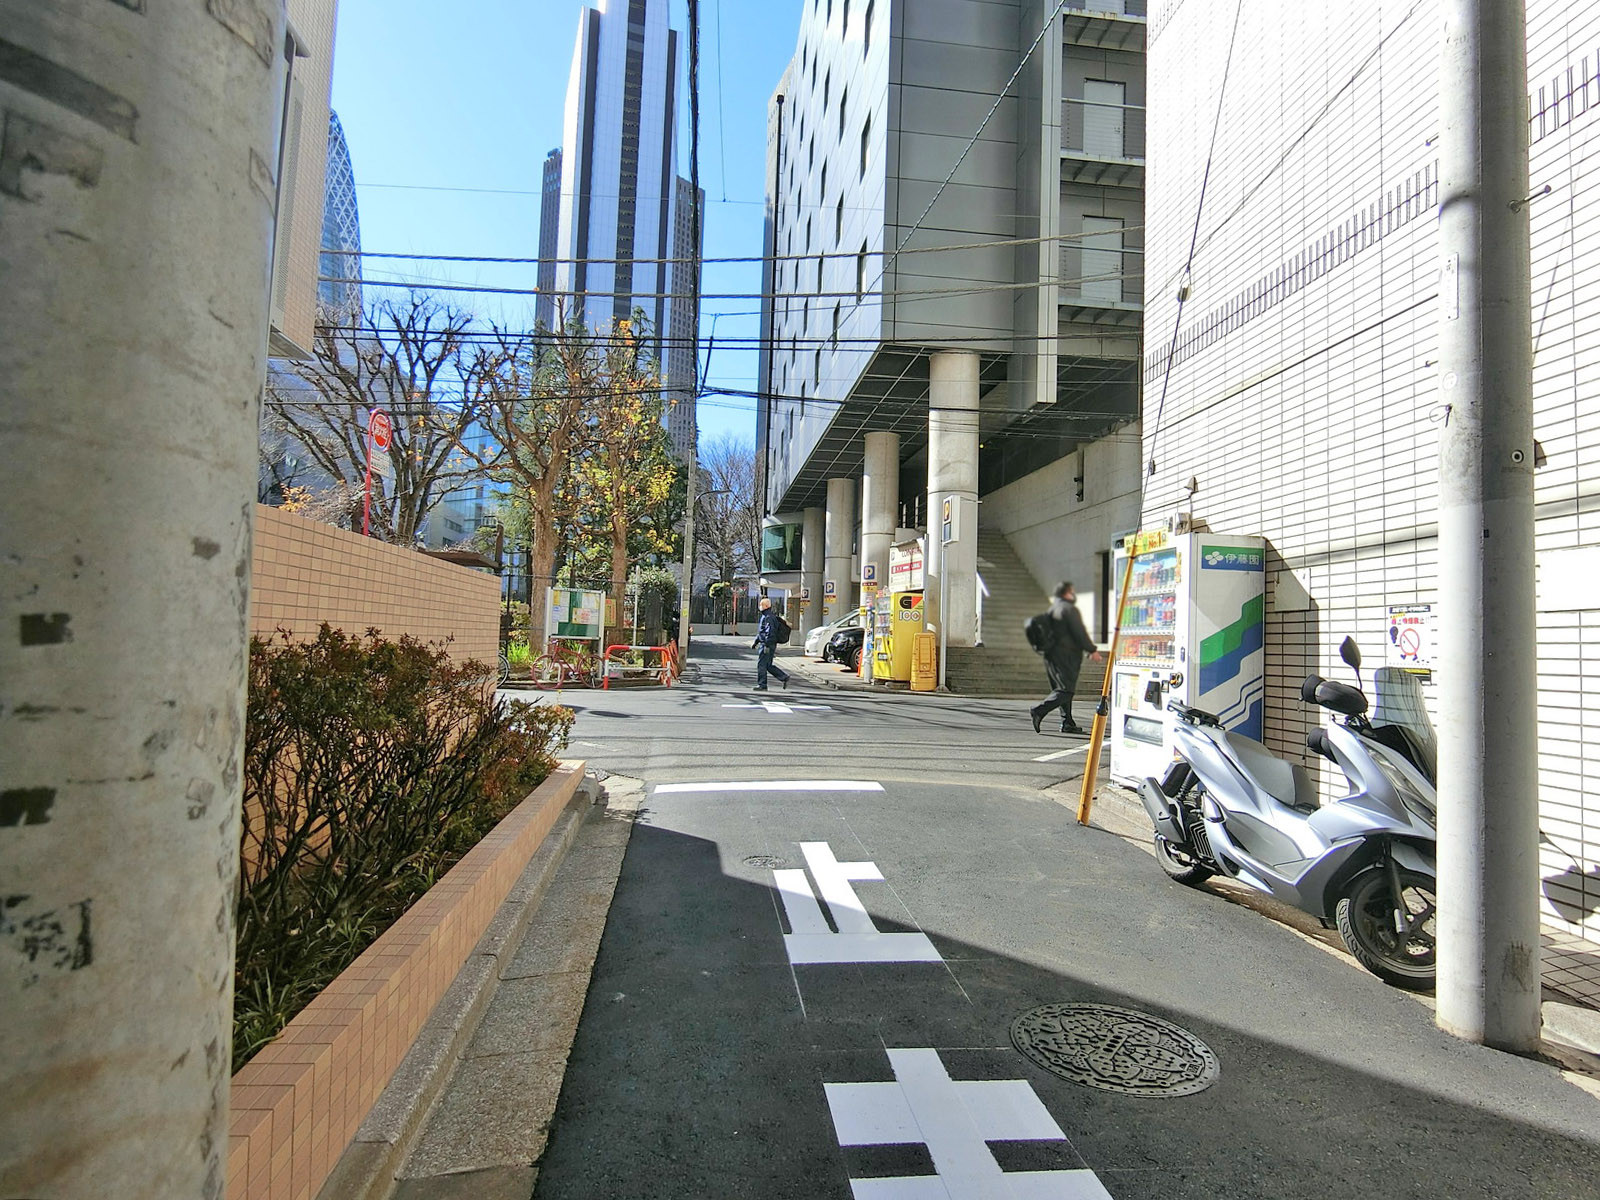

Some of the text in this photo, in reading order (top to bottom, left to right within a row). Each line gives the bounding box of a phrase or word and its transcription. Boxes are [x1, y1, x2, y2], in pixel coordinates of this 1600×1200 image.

[1225, 553, 1260, 566] 伊藤園
[864, 566, 874, 579] P
[899, 610, 921, 621] 100
